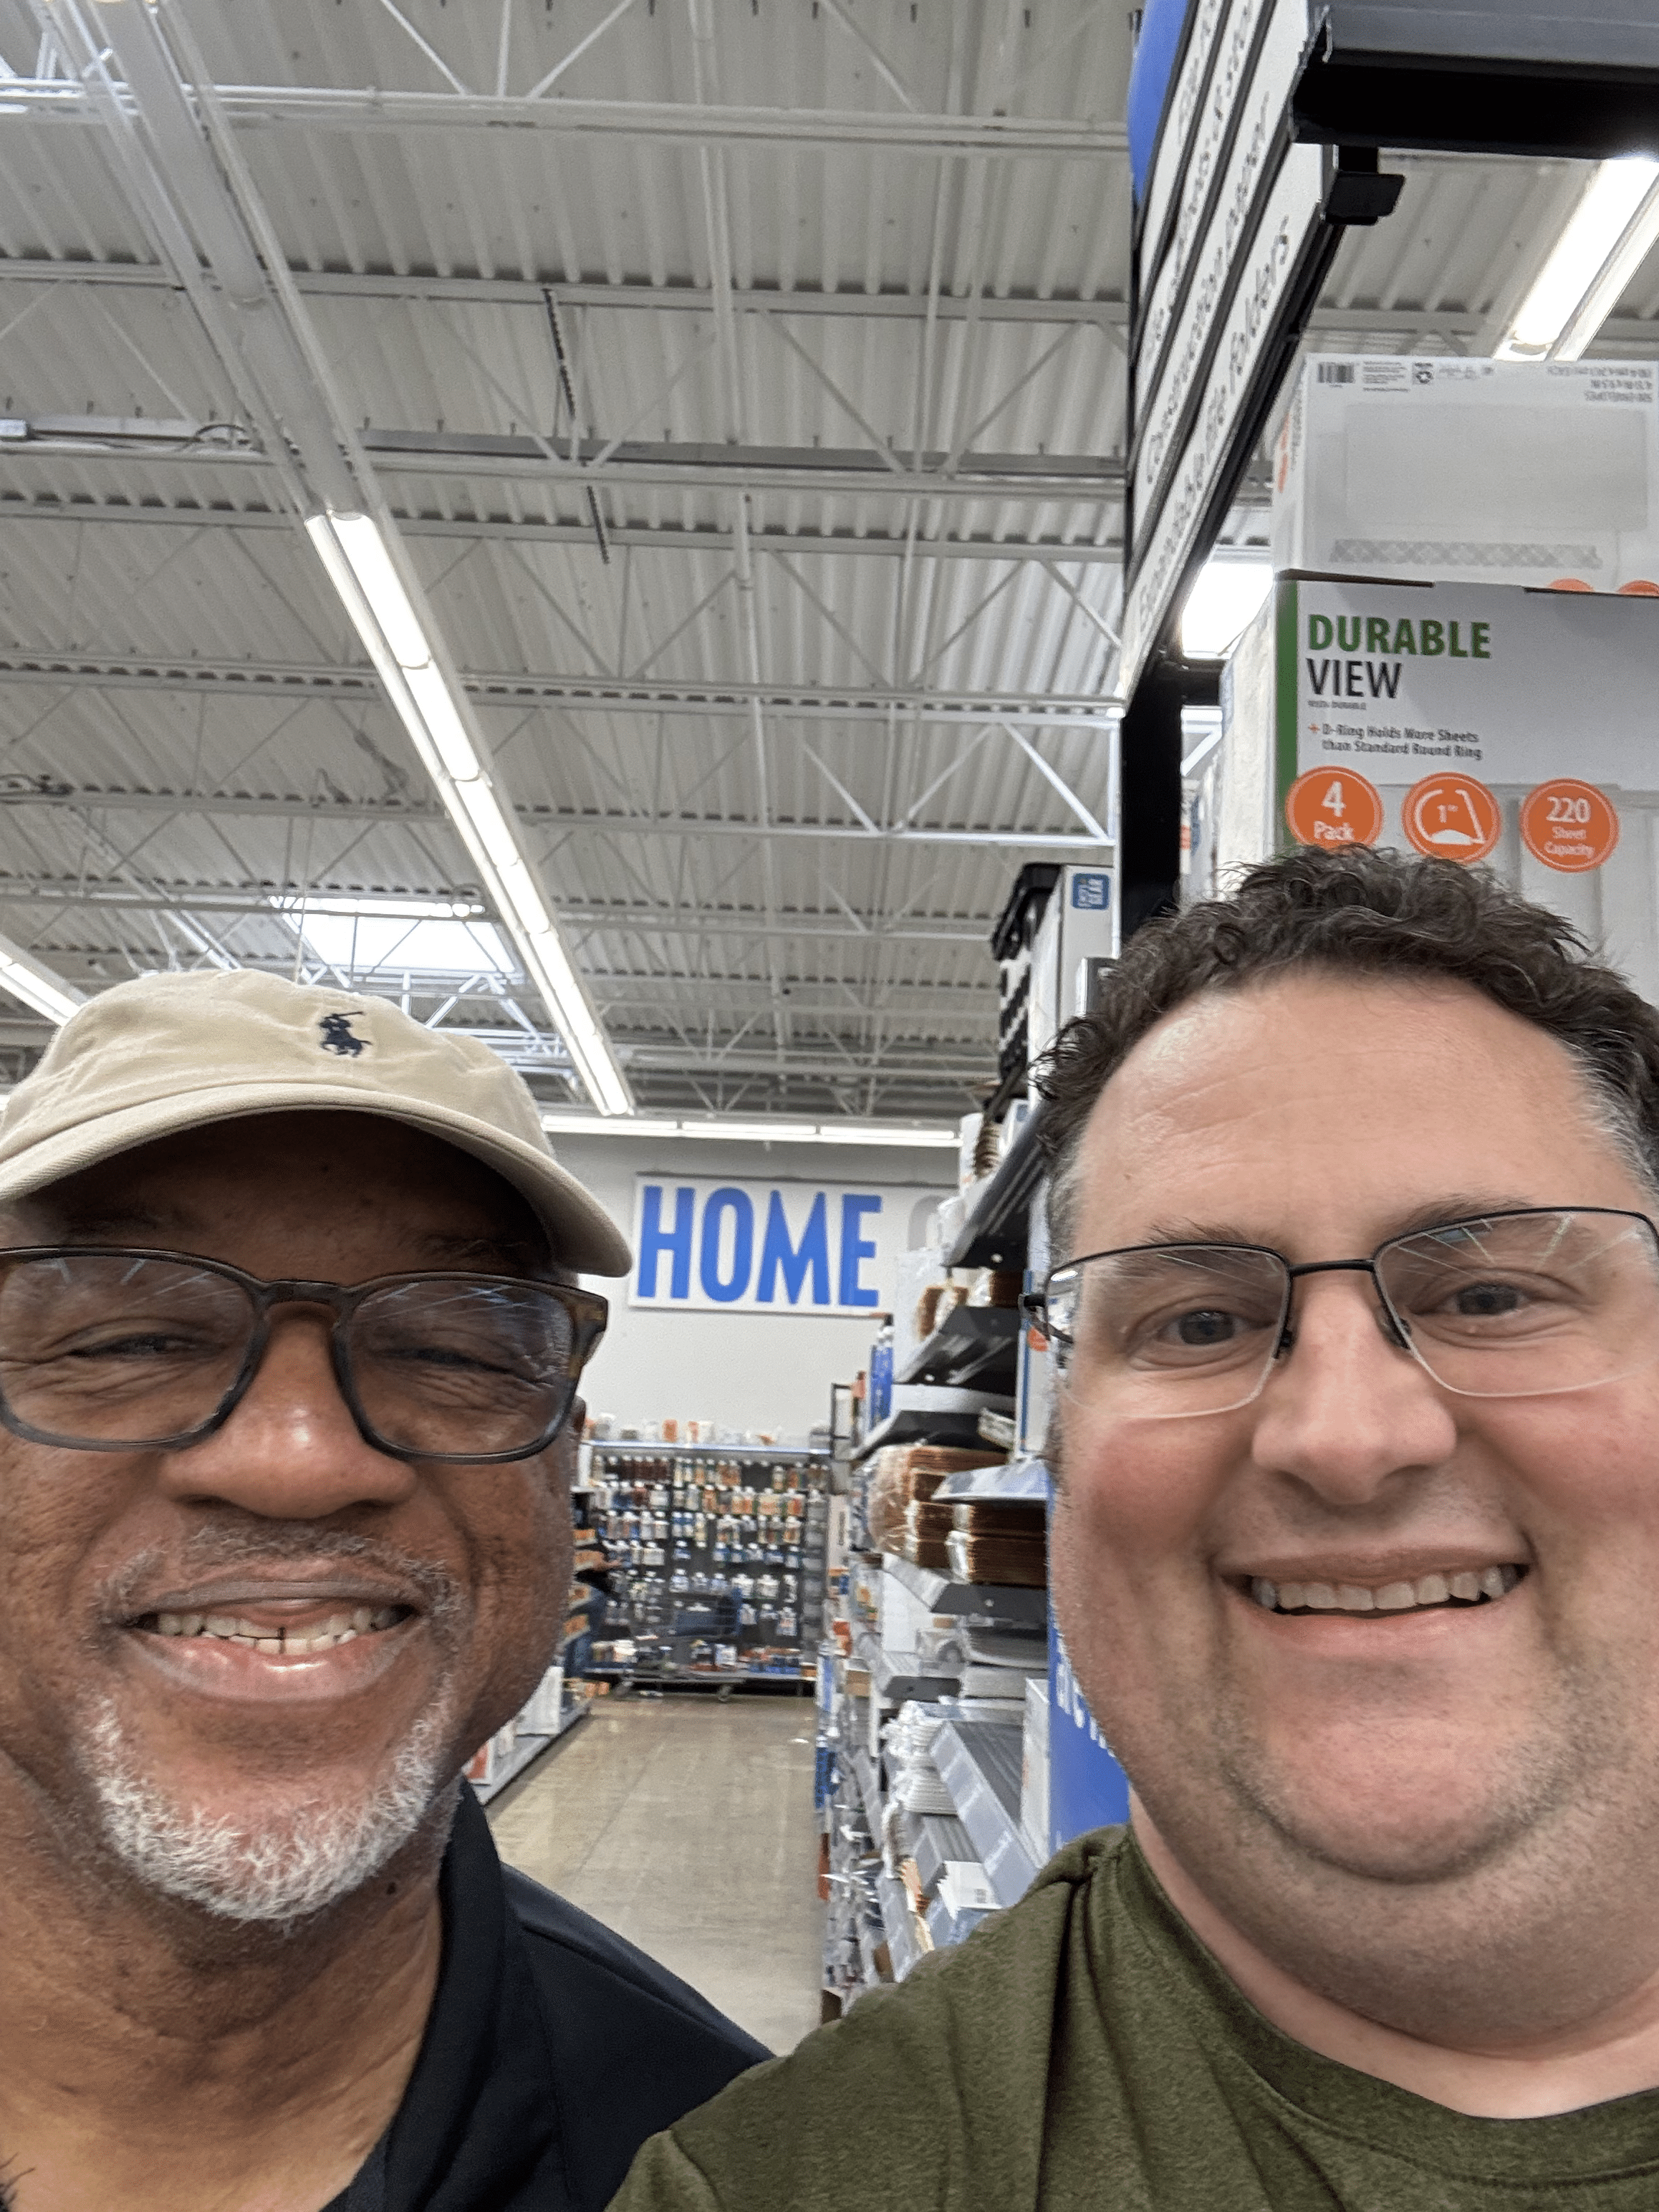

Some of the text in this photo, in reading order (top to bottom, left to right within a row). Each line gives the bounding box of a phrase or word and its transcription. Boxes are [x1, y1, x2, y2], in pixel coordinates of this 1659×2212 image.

[1309, 614, 1491, 659] DURABLE
[1307, 658, 1403, 699] VIEW
[1353, 740, 1409, 754] Standard
[1437, 728, 1479, 742] Sheets
[1321, 781, 1347, 817] 4
[1545, 796, 1591, 824] 220
[1313, 820, 1355, 840] Pack
[1552, 826, 1587, 840] Sheet
[1544, 841, 1595, 860] Capacity
[637, 1184, 883, 1308] HOME
